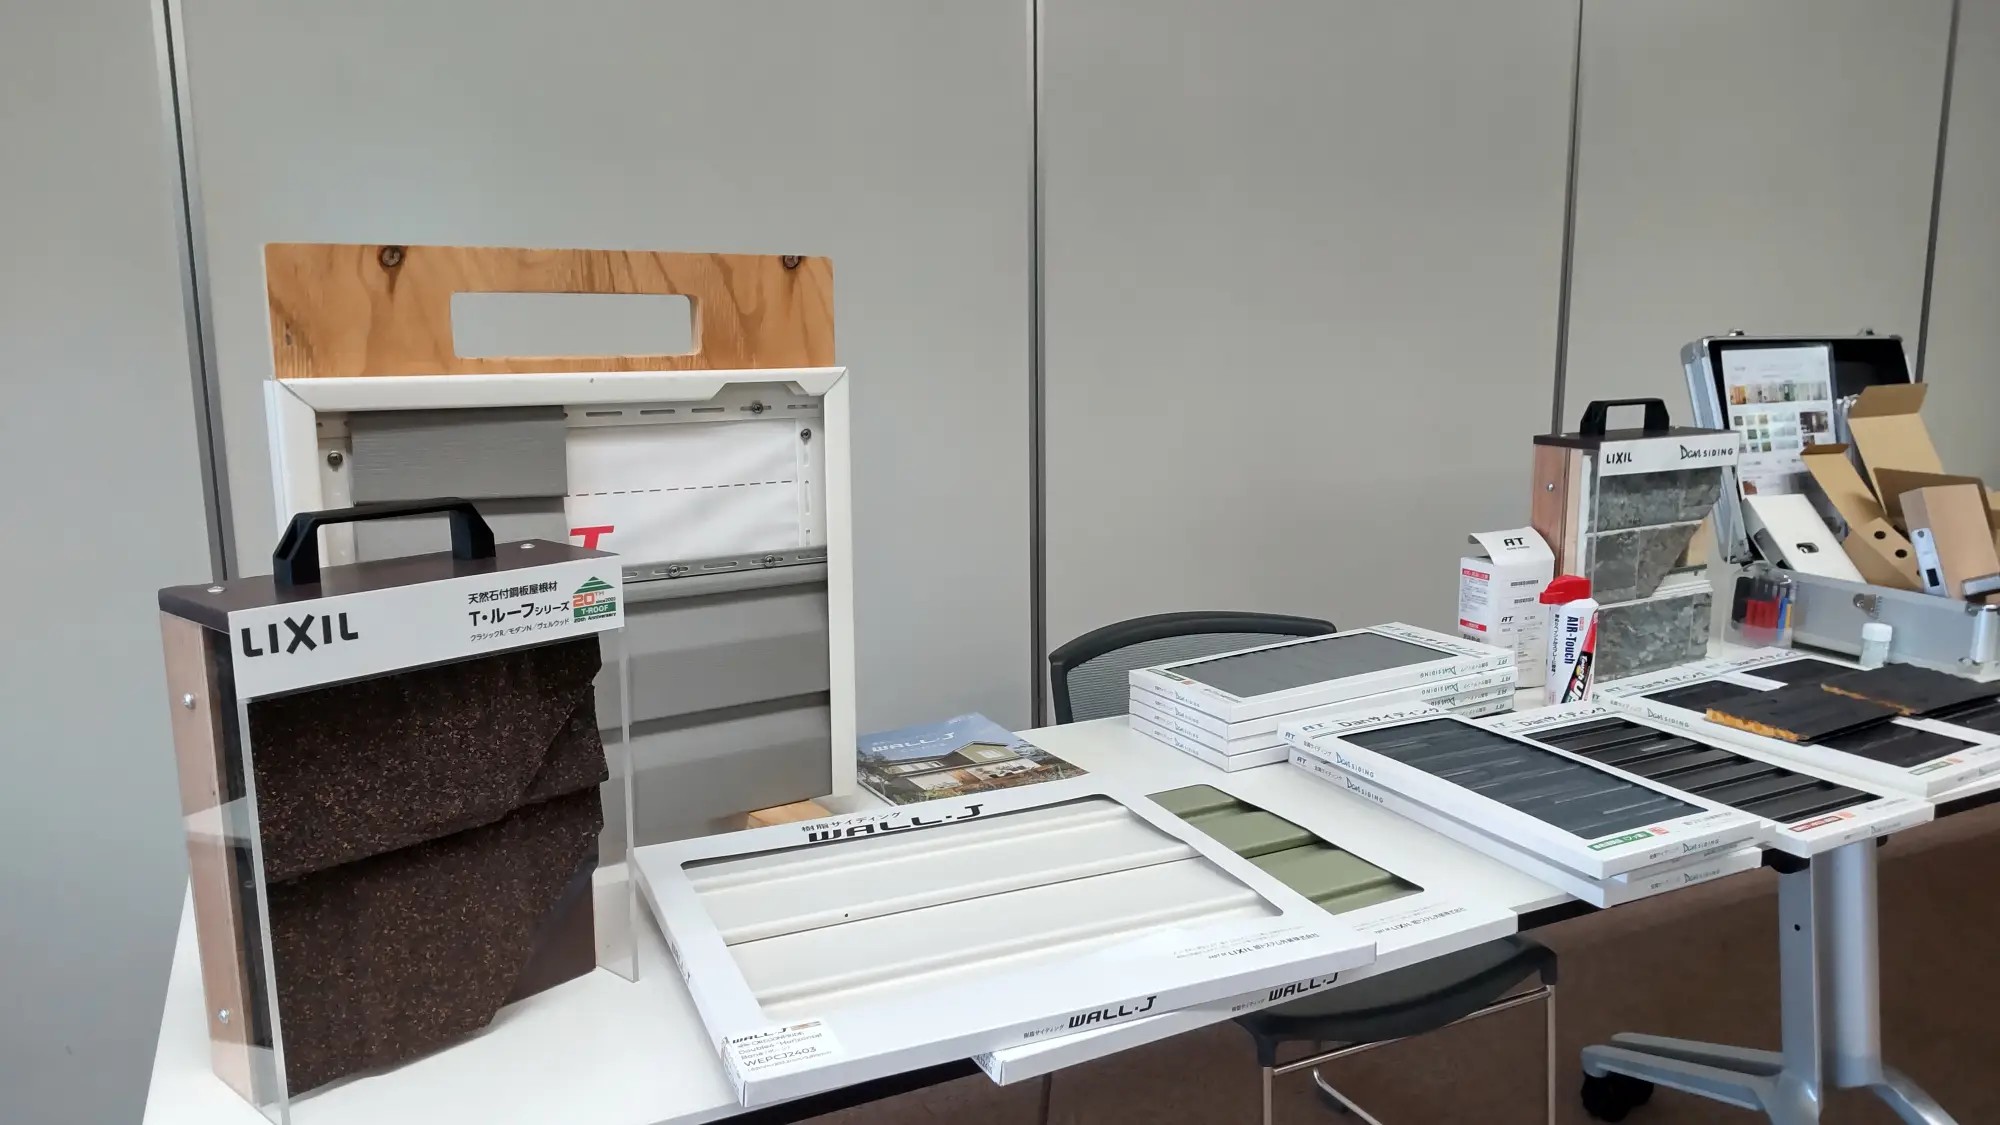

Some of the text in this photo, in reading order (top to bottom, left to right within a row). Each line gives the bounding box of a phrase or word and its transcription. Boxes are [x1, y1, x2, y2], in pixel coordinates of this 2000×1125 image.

[1606, 452, 1632, 465] LIXIL
[1703, 447, 1733, 458] SIDING
[570, 525, 614, 552] T
[1503, 537, 1523, 546] AT
[467, 580, 558, 604] 天然石付鋼板屋根材
[581, 604, 609, 615] T-ROOF
[587, 612, 616, 621] Anniversary
[1501, 615, 1514, 623] AT
[241, 612, 359, 658] LIXIL
[1564, 615, 1579, 665] AIR-Touch
[1351, 764, 1375, 779] SIDING
[1361, 788, 1384, 804] SIDING
